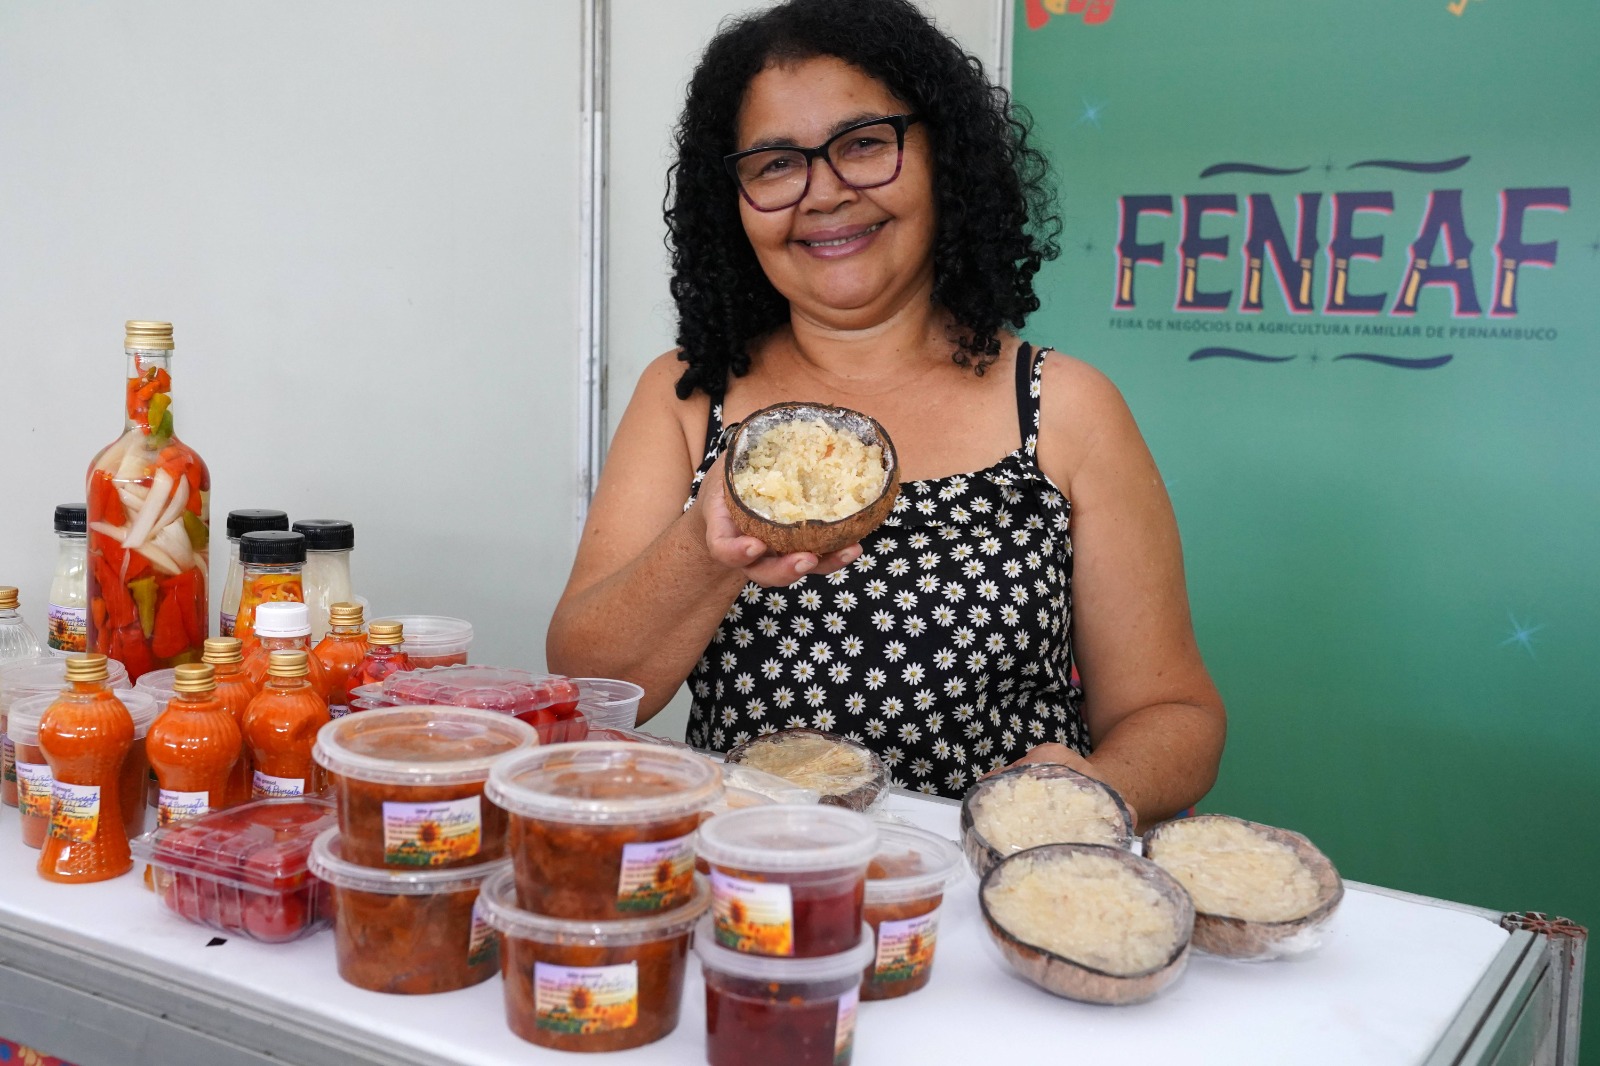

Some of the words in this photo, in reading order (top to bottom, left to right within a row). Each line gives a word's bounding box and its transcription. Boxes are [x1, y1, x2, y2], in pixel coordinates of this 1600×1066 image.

[1112, 187, 1571, 318] FENEAF
[1109, 318, 1143, 329] FEIRA
[1146, 319, 1163, 330] DE
[1166, 318, 1232, 332] NEGÓCIOS
[1234, 321, 1252, 333] DA
[1257, 322, 1350, 336] AGRICULTURA
[1355, 325, 1421, 338] FAMILIAR
[1425, 327, 1444, 338] DE
[1450, 327, 1558, 341] PERNAMBUCO
